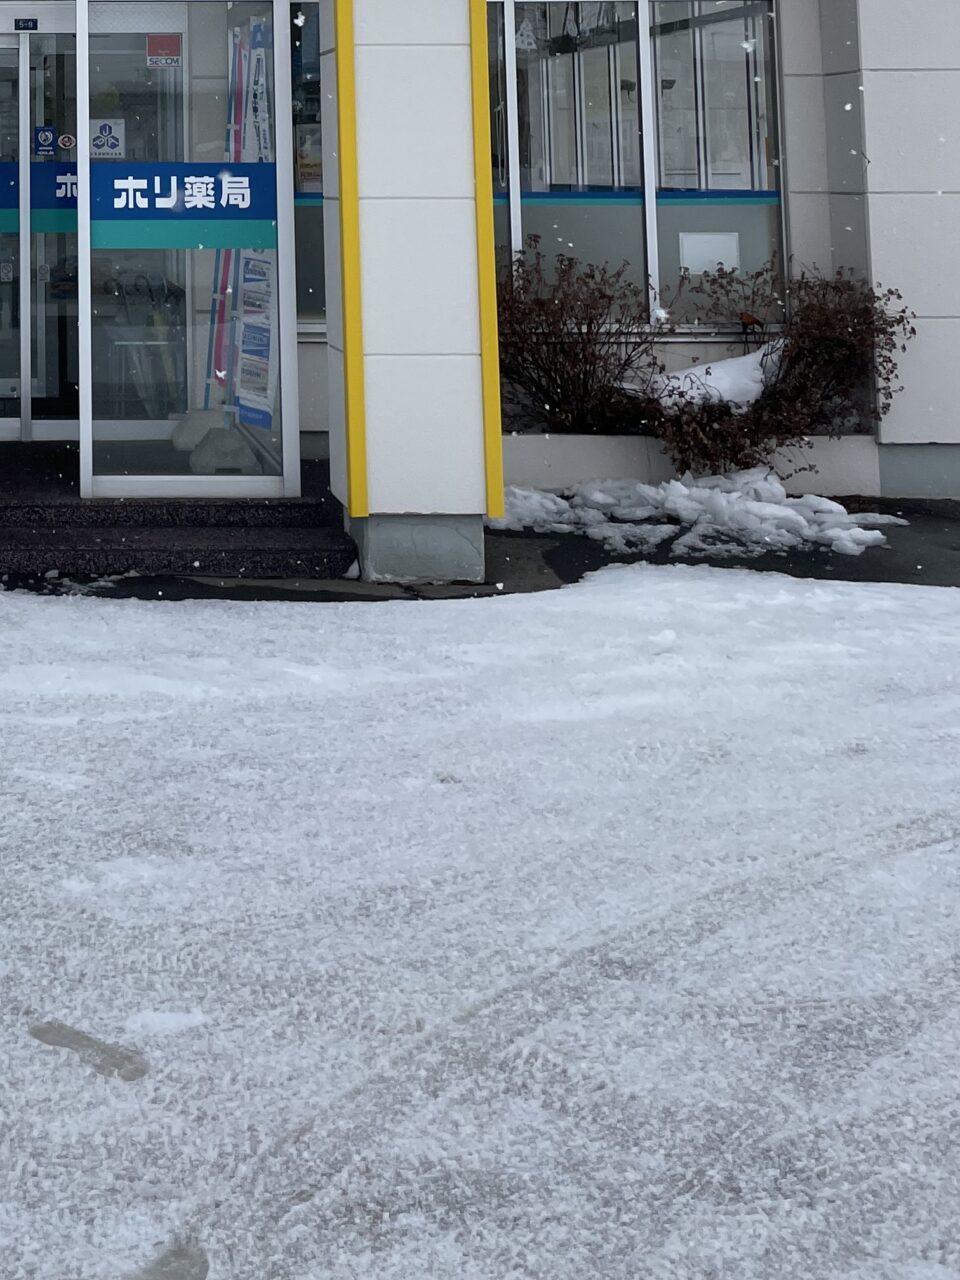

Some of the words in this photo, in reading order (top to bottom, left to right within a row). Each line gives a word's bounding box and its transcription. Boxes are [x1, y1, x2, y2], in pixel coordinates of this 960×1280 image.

[148, 57, 180, 66] SECOM
[113, 175, 251, 209] ホリ薬局
